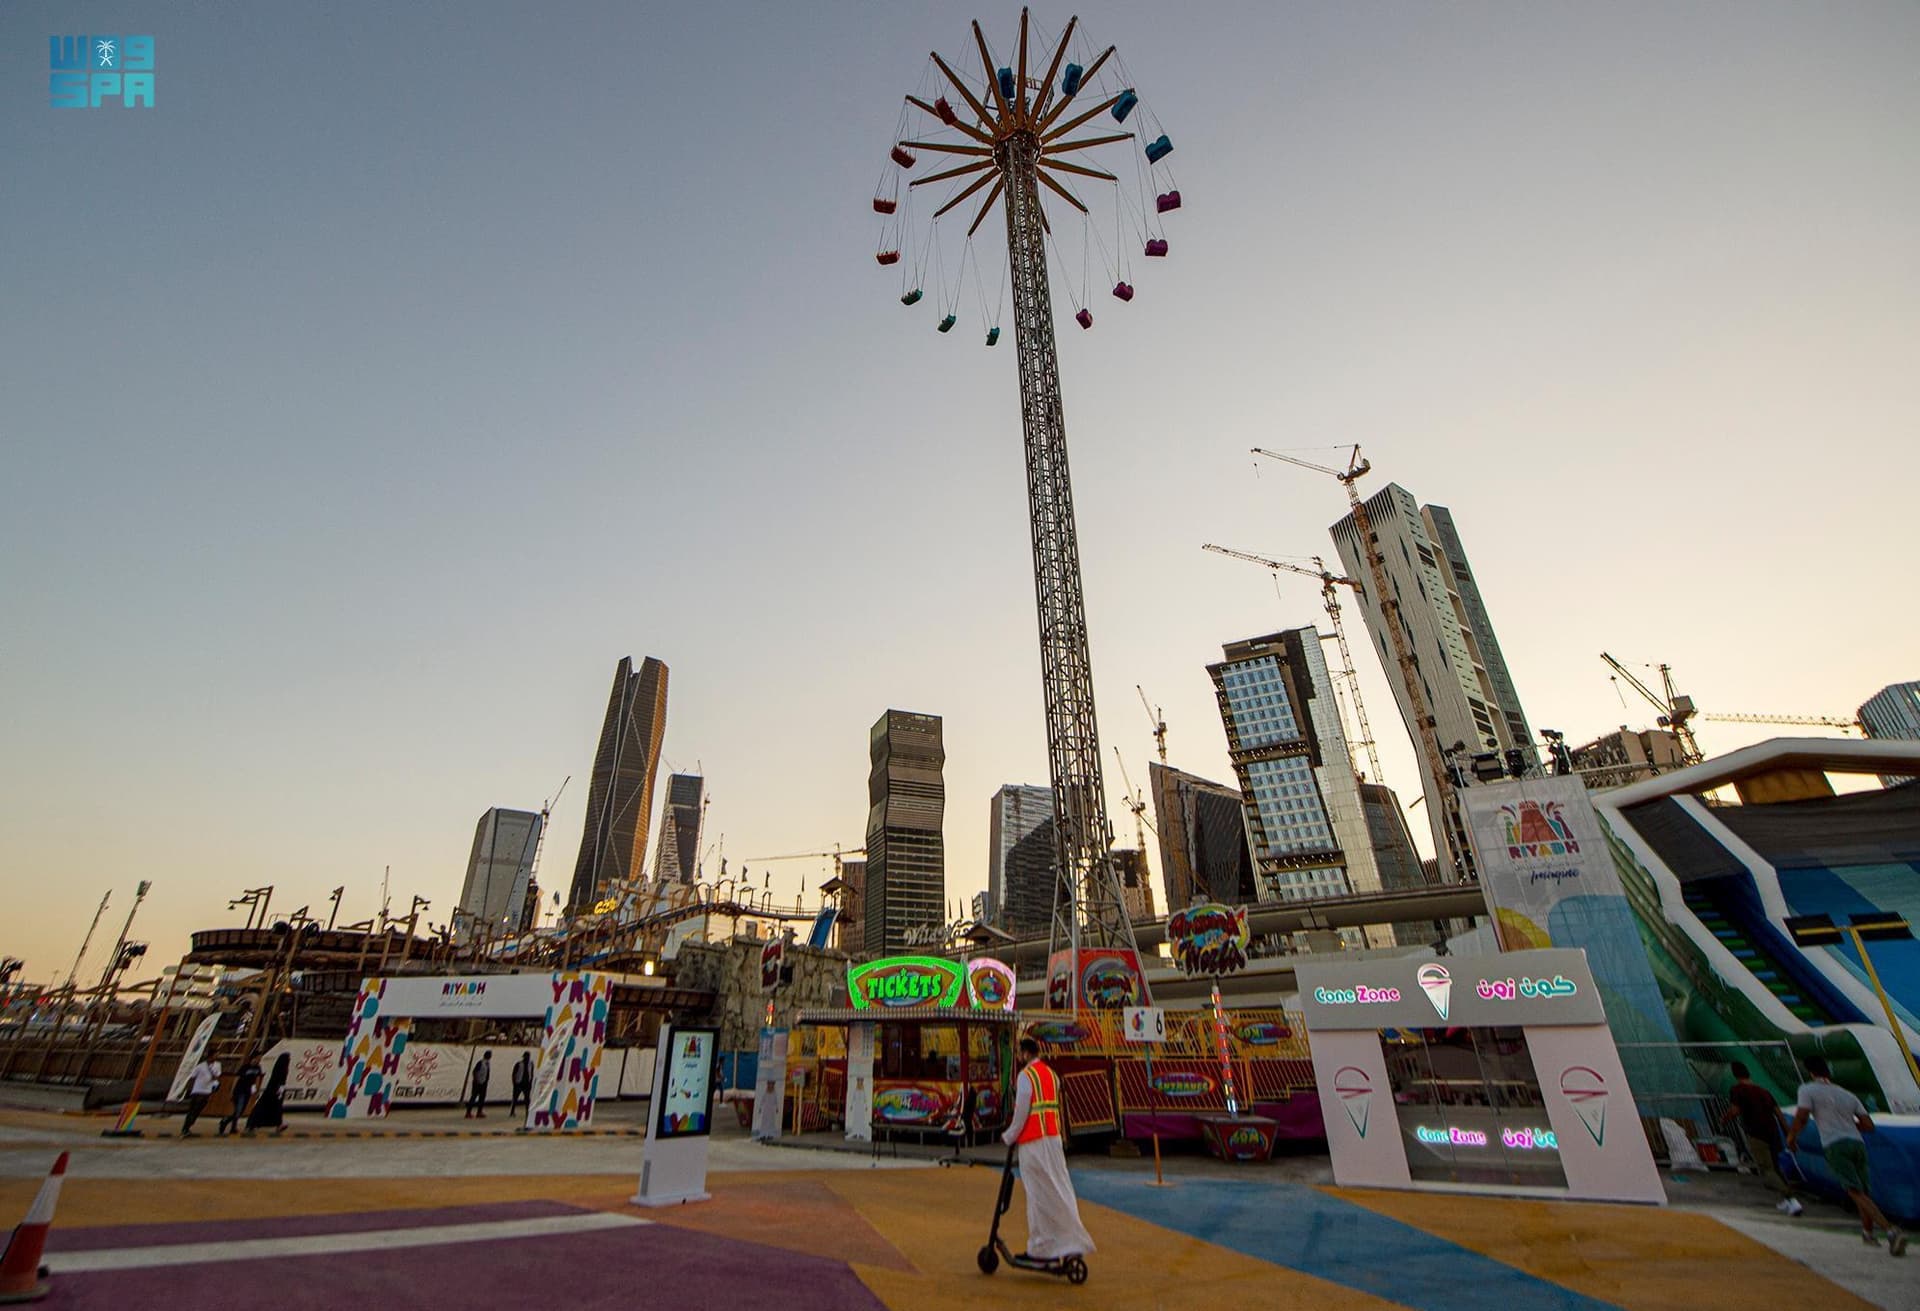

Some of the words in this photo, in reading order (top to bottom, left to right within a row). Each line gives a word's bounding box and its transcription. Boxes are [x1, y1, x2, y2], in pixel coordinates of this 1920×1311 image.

[1508, 840, 1580, 858] RIYADH
[442, 981, 487, 996] RIYADH
[867, 970, 942, 1000] TICKETS
[1314, 986, 1355, 1004] Cone
[1356, 984, 1401, 1003] Zone
[1476, 977, 1516, 1000] زون
[1519, 974, 1577, 999] كون
[1155, 1012, 1164, 1036] 6
[1450, 1127, 1487, 1146] Zone
[1534, 1128, 1559, 1148] ون
